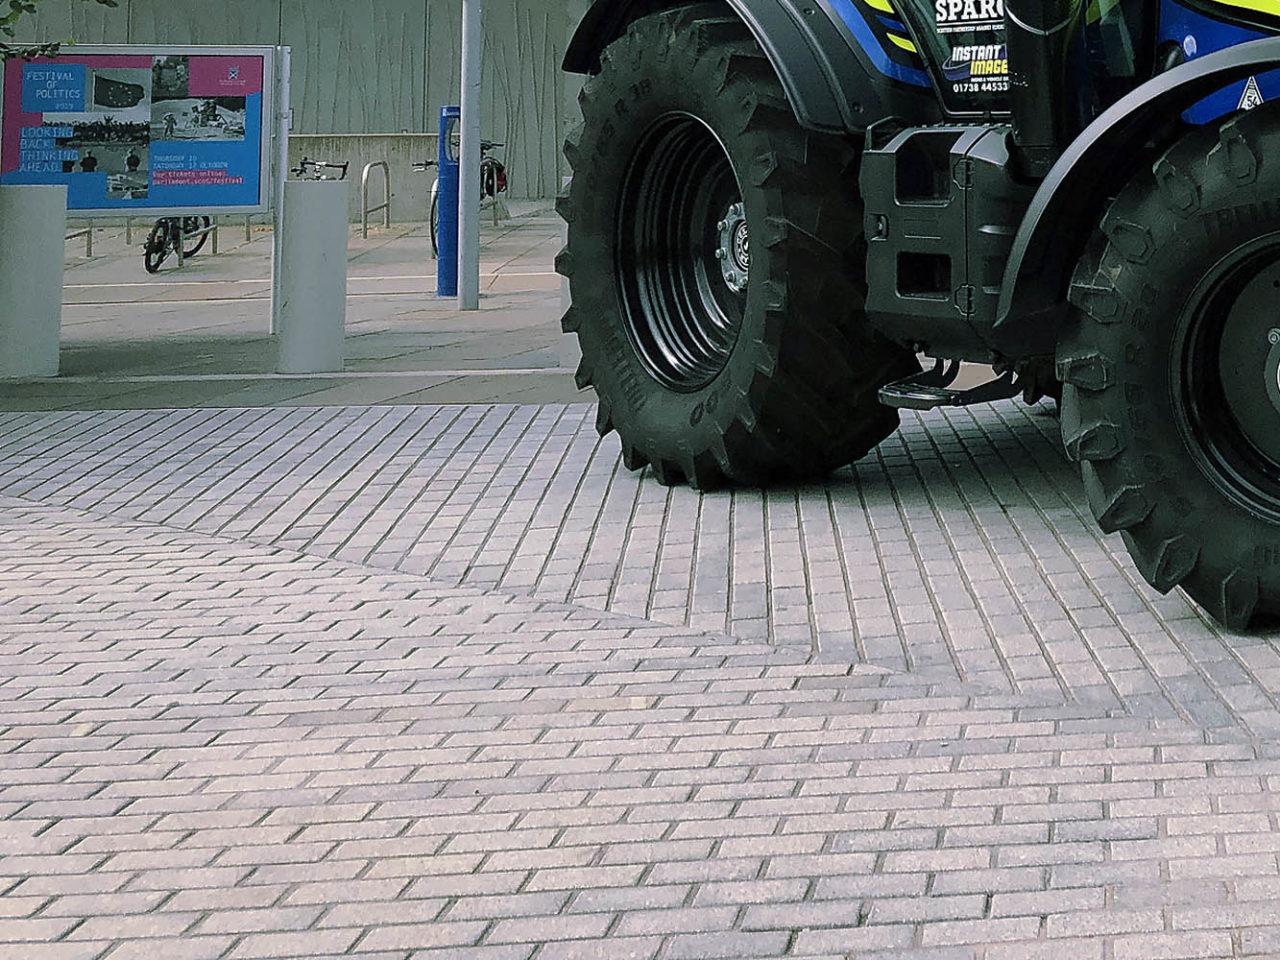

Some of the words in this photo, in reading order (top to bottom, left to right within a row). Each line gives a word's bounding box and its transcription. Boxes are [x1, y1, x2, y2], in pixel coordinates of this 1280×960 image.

[952, 44, 1002, 61] INSTANT
[970, 59, 1009, 75] IMAGE
[26, 71, 75, 81] FESTIVAL
[46, 81, 57, 89] OF
[953, 83, 979, 93] 01738
[36, 89, 81, 99] POLITICS
[21, 127, 73, 138] LOOKING
[21, 150, 79, 161] THINKING
